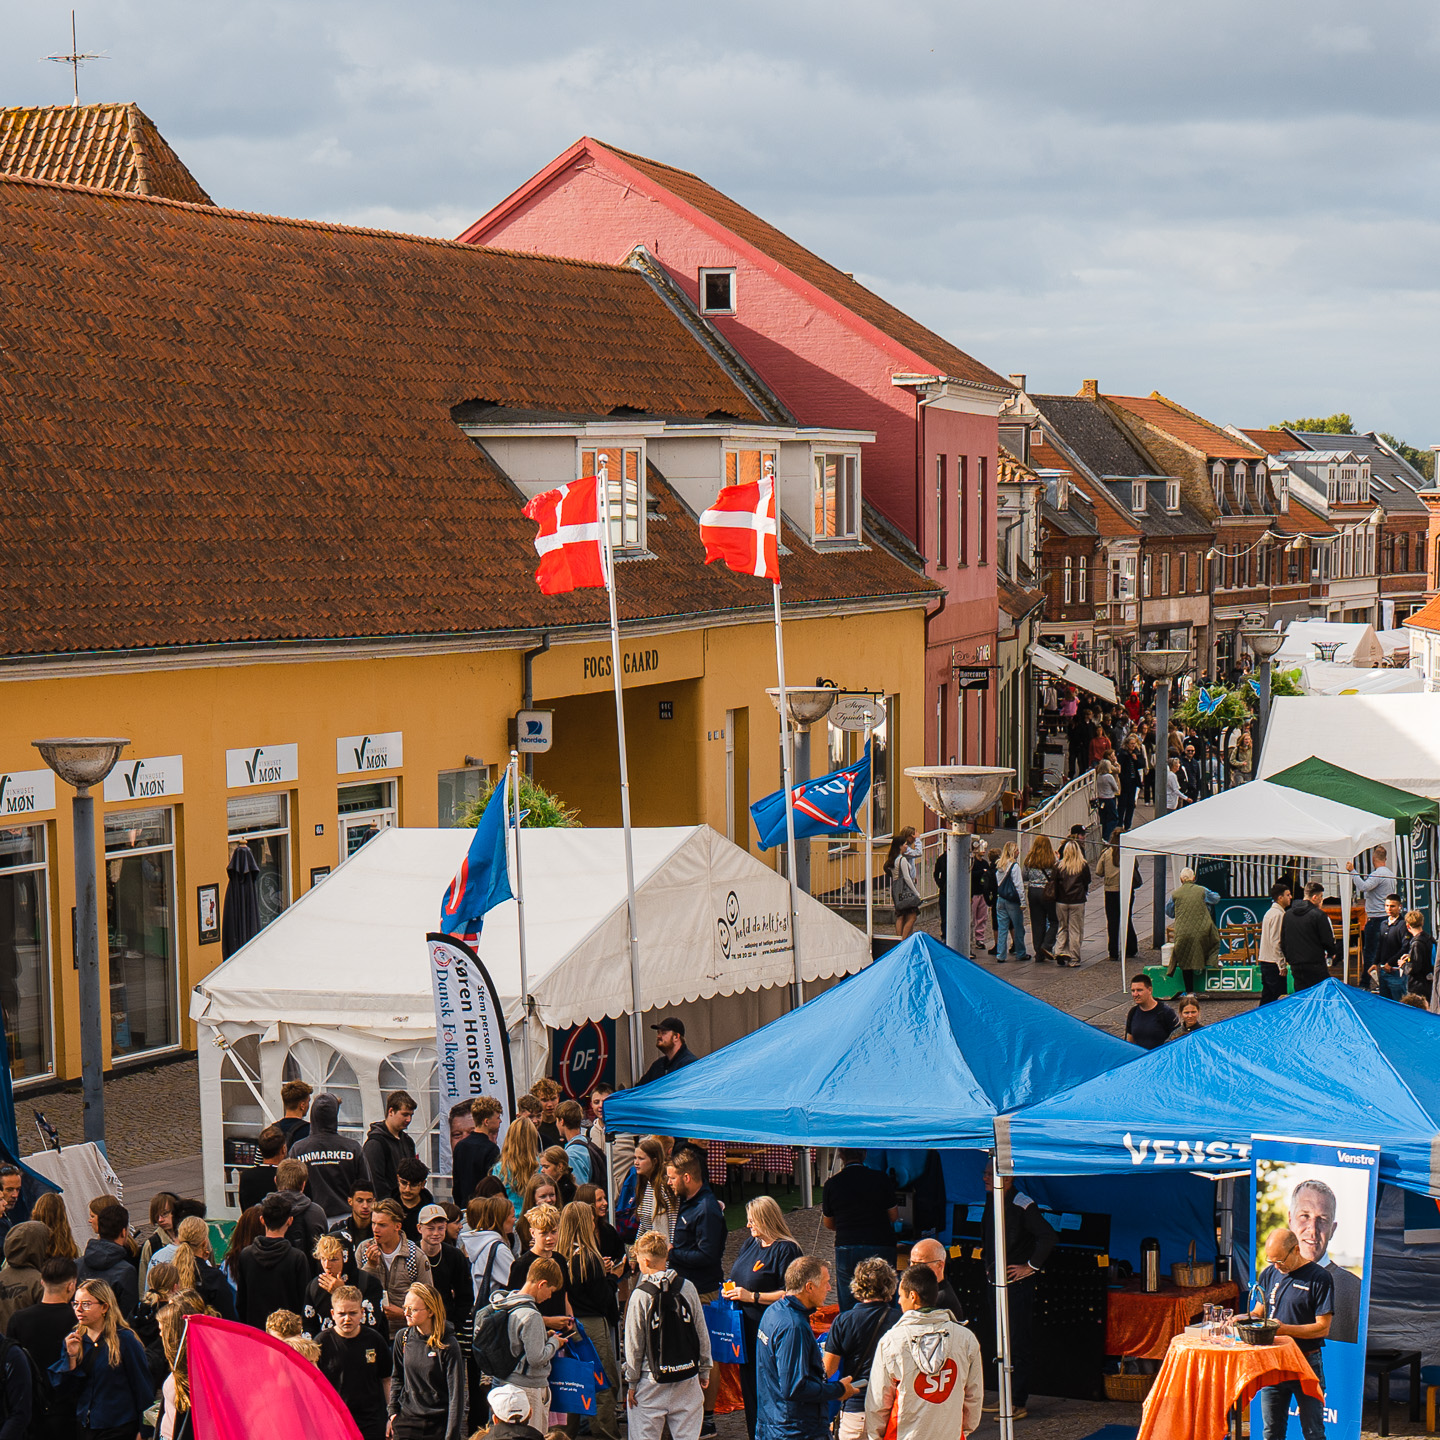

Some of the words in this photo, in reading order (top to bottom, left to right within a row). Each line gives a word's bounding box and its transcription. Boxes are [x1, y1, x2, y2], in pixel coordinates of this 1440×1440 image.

[623, 650, 659, 674] GAARD
[366, 754, 388, 769] MØN
[139, 771, 165, 780] VINHUSET
[259, 767, 282, 783] MØN
[6, 786, 35, 796] VINHUSET
[139, 780, 165, 796] MØN
[6, 795, 35, 813] MØN
[435, 968, 455, 1018] Dansk
[477, 985, 487, 1012] Stem
[479, 1013, 495, 1071] personligt
[442, 1022, 461, 1098] Folkeparti
[463, 1019, 483, 1095] Hansen
[571, 1048, 596, 1072] DF
[489, 1071, 499, 1086] på
[297, 1150, 354, 1163] UNMARKED
[1336, 1150, 1376, 1166] Venstre
[668, 1360, 695, 1373] hummel
[923, 1368, 953, 1394] SF
